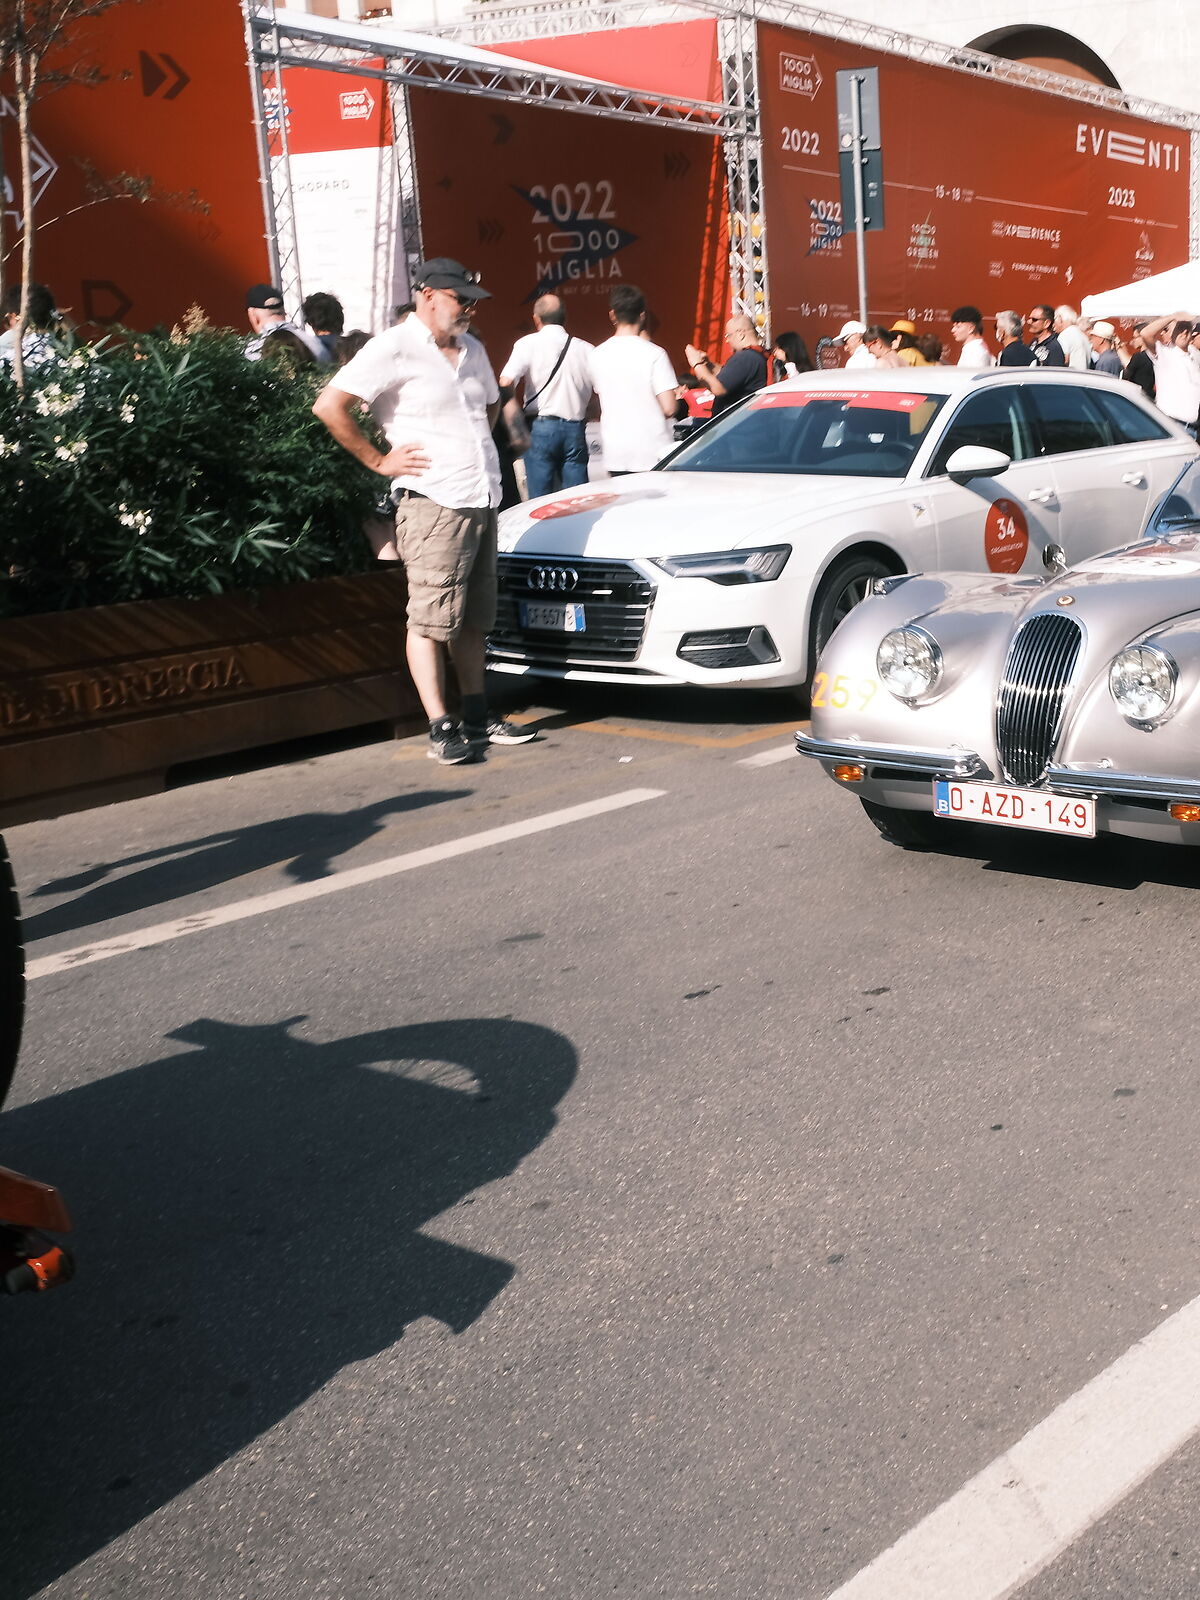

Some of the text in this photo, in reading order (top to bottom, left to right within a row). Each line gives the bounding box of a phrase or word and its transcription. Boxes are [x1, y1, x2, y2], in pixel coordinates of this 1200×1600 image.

[783, 58, 811, 75] 1000
[782, 74, 813, 92] MIGLIA
[781, 126, 820, 156] 2022
[1076, 123, 1179, 172] EVENTI
[529, 180, 616, 224] 2022
[1108, 186, 1135, 208] 2023
[809, 199, 842, 223] 2022
[533, 229, 620, 254] 1000
[810, 222, 842, 238] 1000
[809, 236, 842, 250] MIGLIA
[536, 258, 622, 281] MIGLIA
[996, 516, 1016, 540] 34
[91, 655, 250, 712] BRESCIA
[811, 671, 879, 712] 259
[938, 799, 949, 812] B
